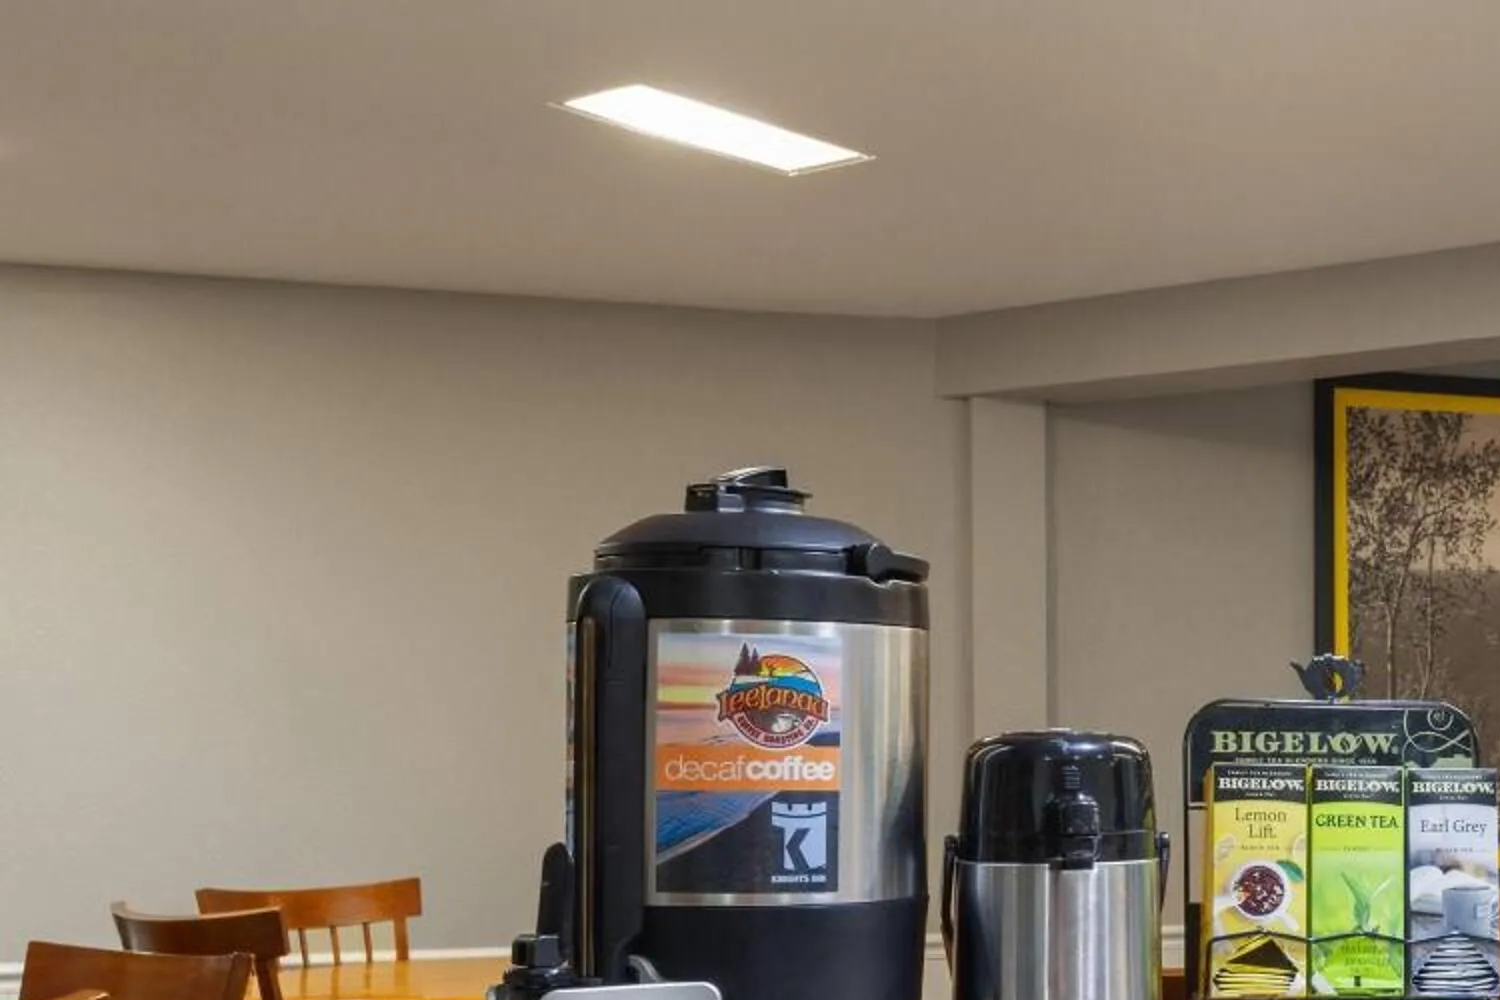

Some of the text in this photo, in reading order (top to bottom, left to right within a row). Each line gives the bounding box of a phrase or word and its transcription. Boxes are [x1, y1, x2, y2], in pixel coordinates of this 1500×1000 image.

[1235, 807, 1287, 823] Lemon
[1315, 813, 1399, 829] GREEN TEA
[1249, 823, 1277, 839] Lift
[1421, 818, 1488, 838] Earl Grey
